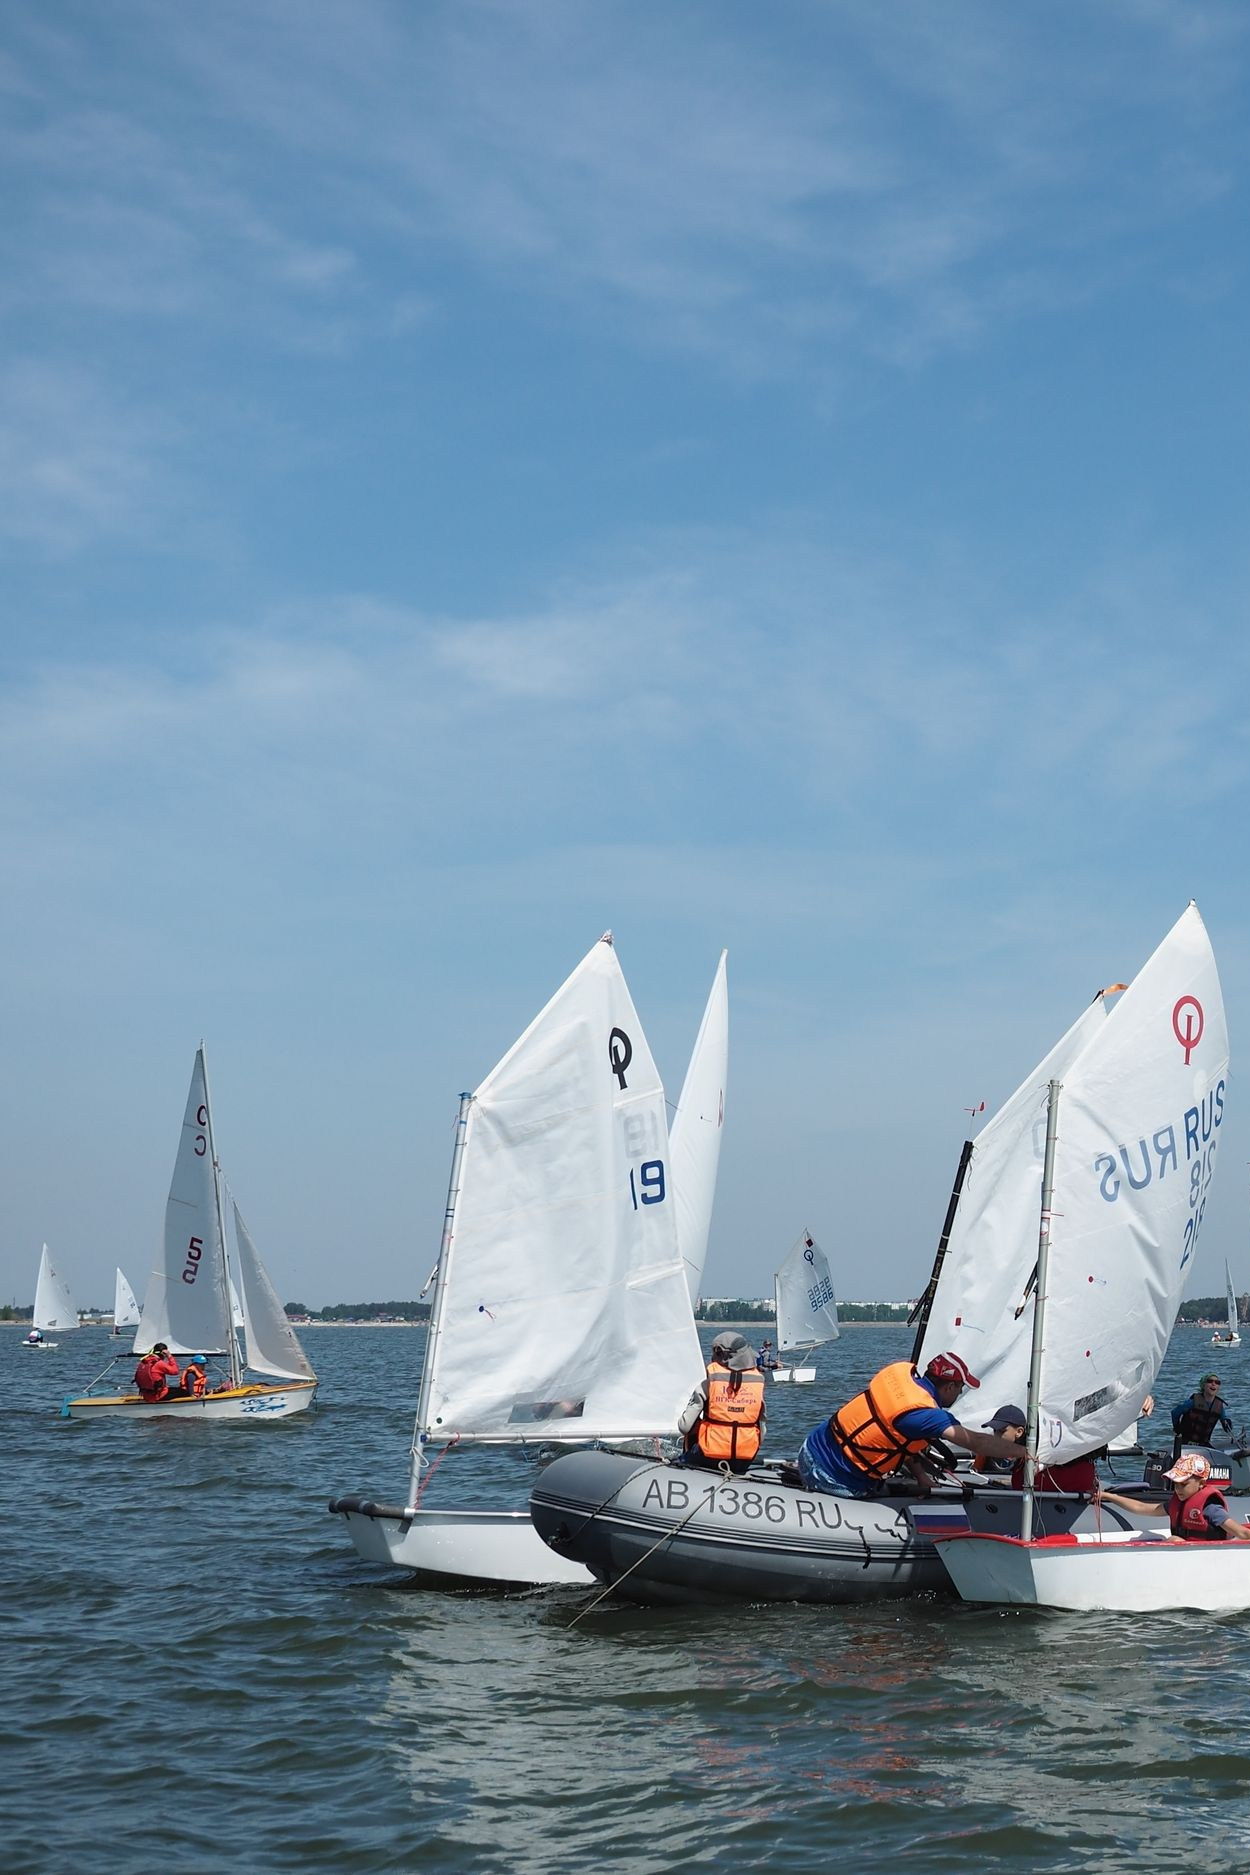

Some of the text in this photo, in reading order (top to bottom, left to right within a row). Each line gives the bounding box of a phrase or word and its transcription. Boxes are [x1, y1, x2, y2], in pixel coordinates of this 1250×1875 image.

[1184, 1079, 1225, 1160] RUS
[630, 1160, 666, 1210] 19
[811, 1287, 834, 1312] 9586
[1209, 1467, 1230, 1479] AMAHA
[642, 1479, 689, 1509] AB
[702, 1485, 786, 1523] 1386
[797, 1499, 863, 1531] RU
